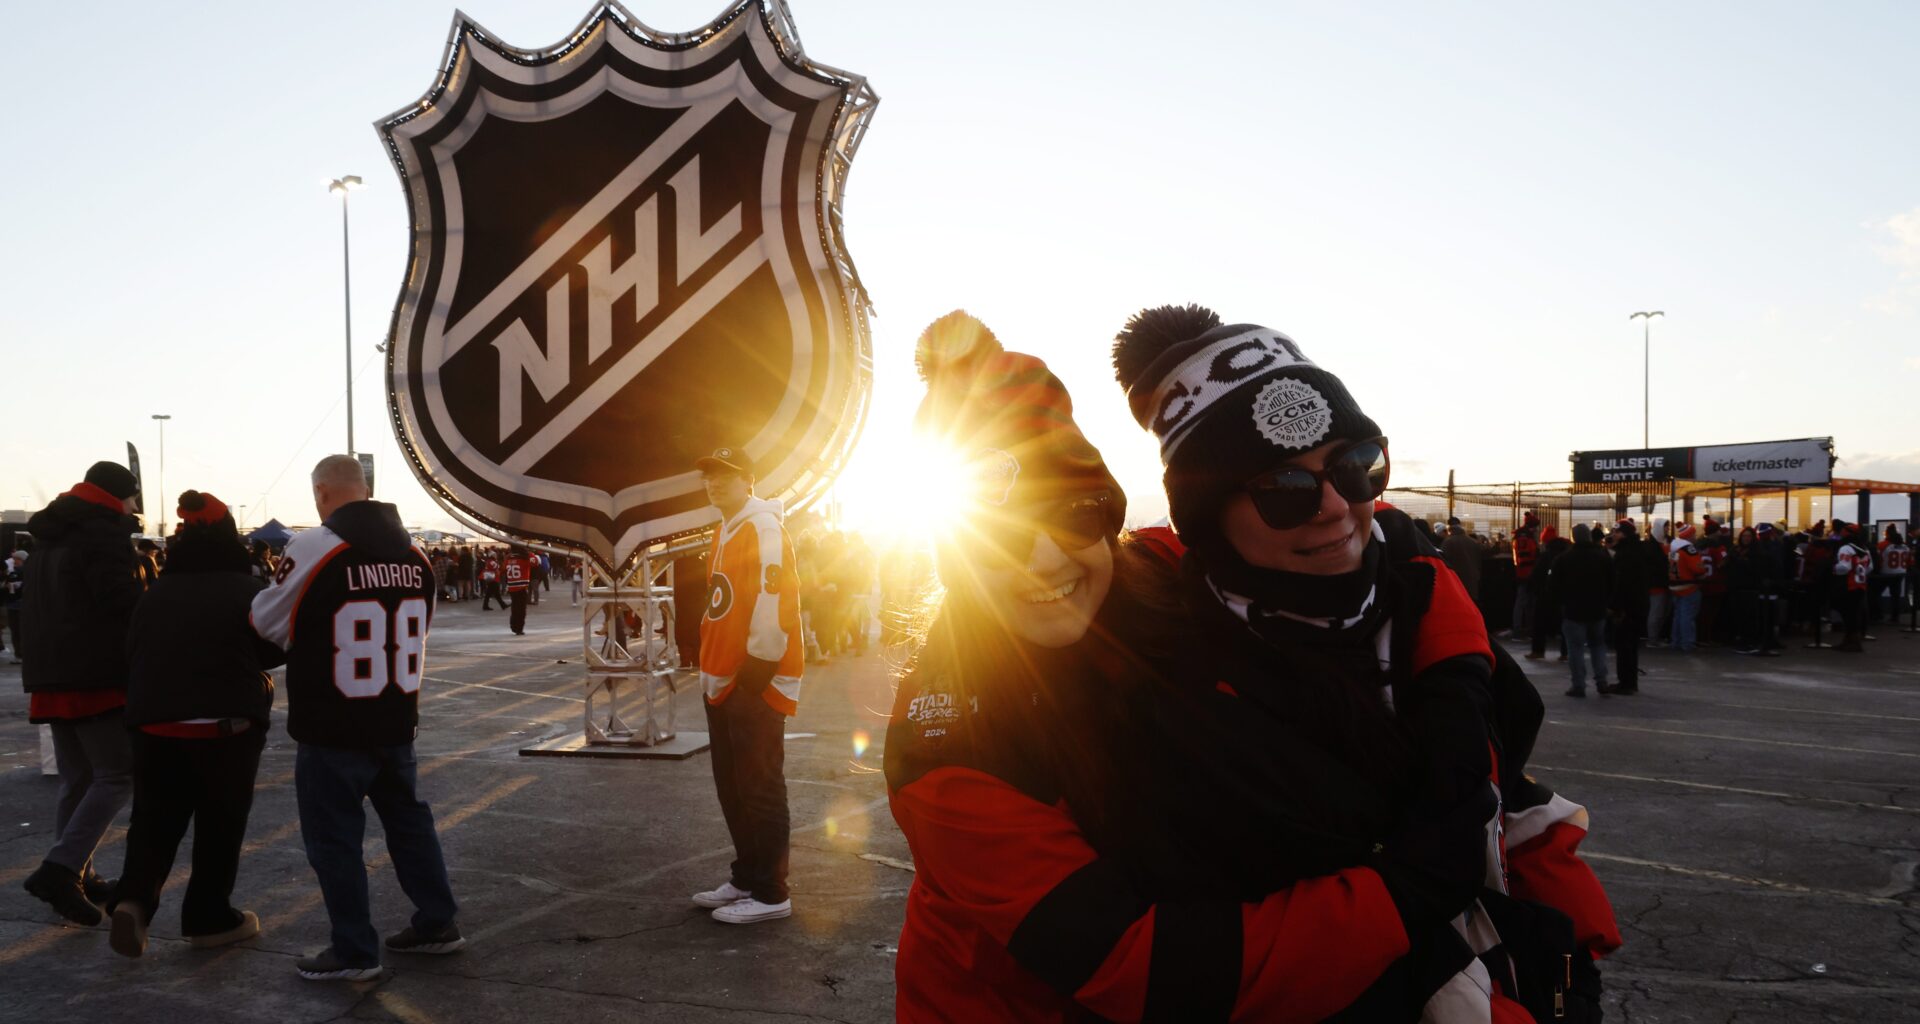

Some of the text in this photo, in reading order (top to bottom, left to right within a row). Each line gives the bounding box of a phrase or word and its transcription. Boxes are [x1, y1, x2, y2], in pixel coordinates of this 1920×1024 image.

[490, 153, 742, 444] NHL
[1258, 402, 1266, 414] THE
[1262, 384, 1289, 401] WORLD'S
[1269, 391, 1302, 410] HOCKEY
[1275, 432, 1296, 441] MADE
[1308, 414, 1326, 437] CANADA
[1284, 415, 1317, 433] STICKS
[1594, 456, 1664, 470] BULLSEYE
[1712, 457, 1806, 472] ticketmaster
[347, 563, 423, 591] LINDROS
[506, 565, 521, 579] 26
[334, 597, 428, 698] 88
[908, 693, 978, 720] STADIM
[924, 728, 947, 737] 2024
